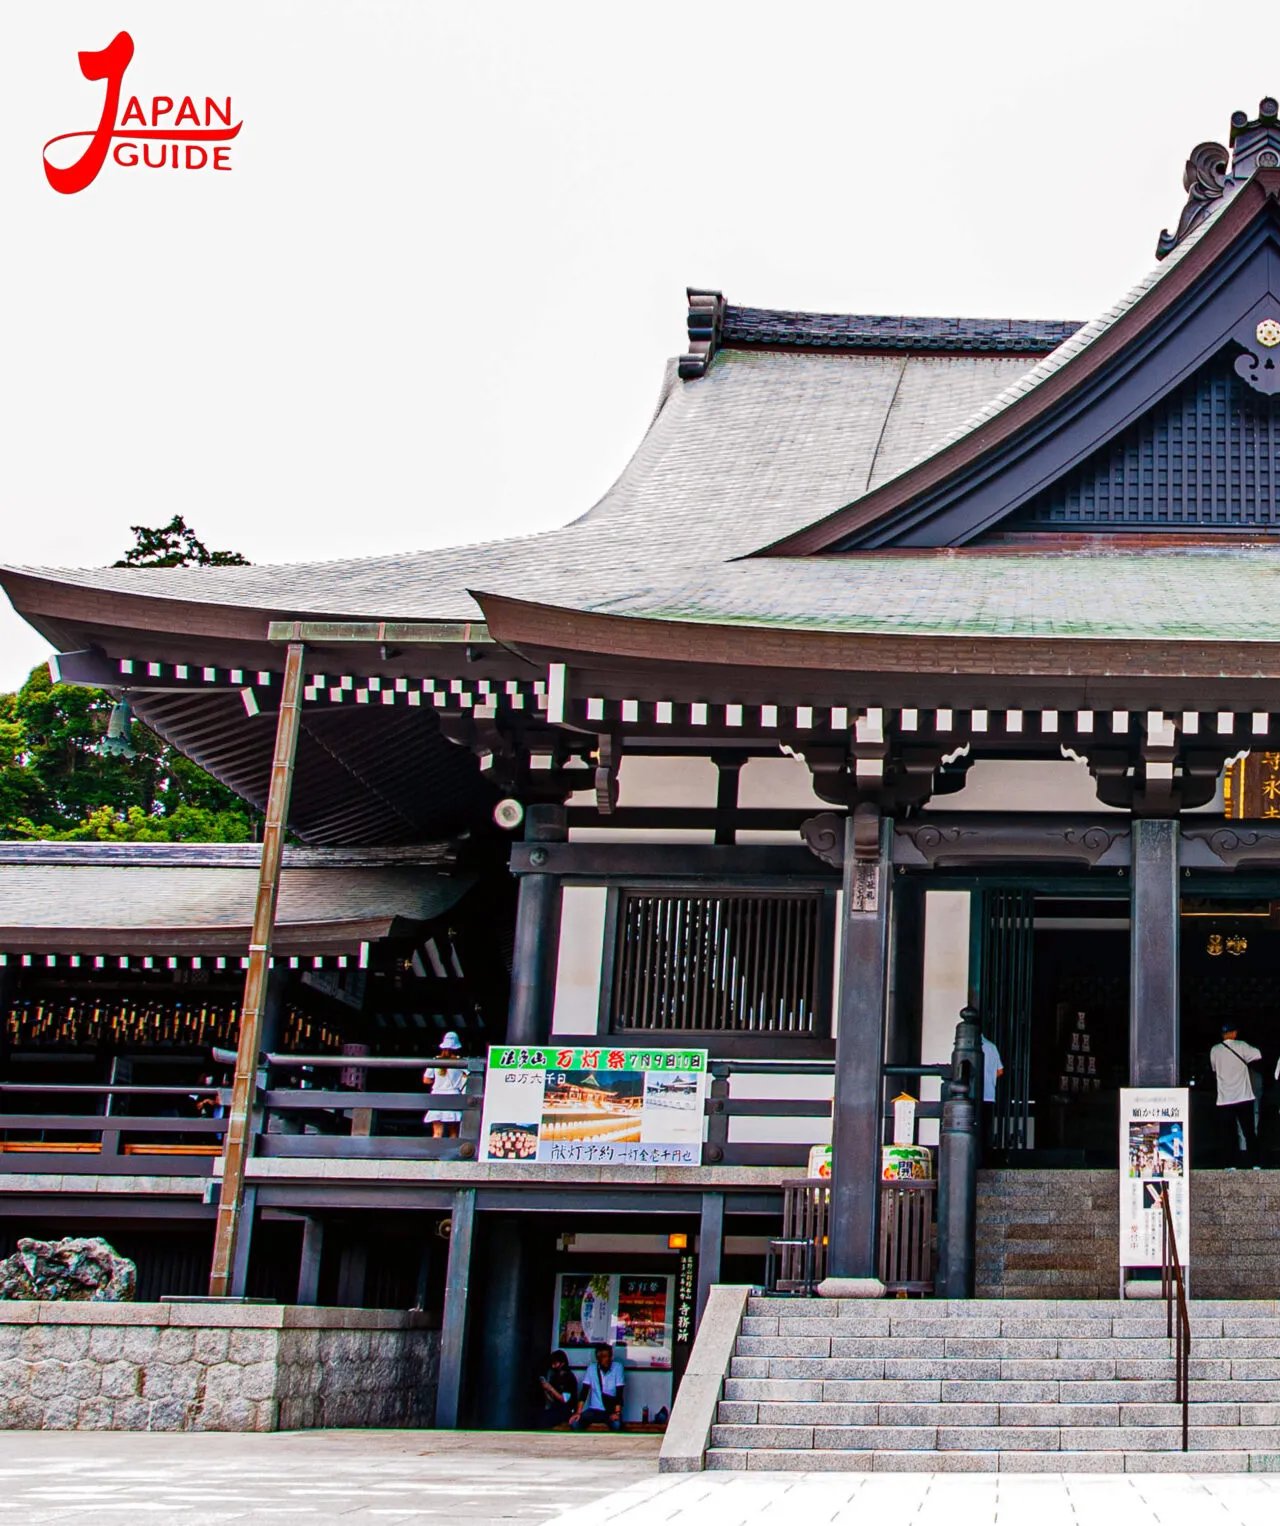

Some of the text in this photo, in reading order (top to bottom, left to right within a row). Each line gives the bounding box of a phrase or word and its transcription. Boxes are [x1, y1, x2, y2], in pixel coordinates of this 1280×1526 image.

[500, 1049, 547, 1067] 法多山
[556, 1049, 625, 1069] 万灯祭
[504, 1073, 567, 1085] 四万六千日
[1132, 1107, 1180, 1118] 願かけ風鈴
[677, 1302, 690, 1342] 寺務所
